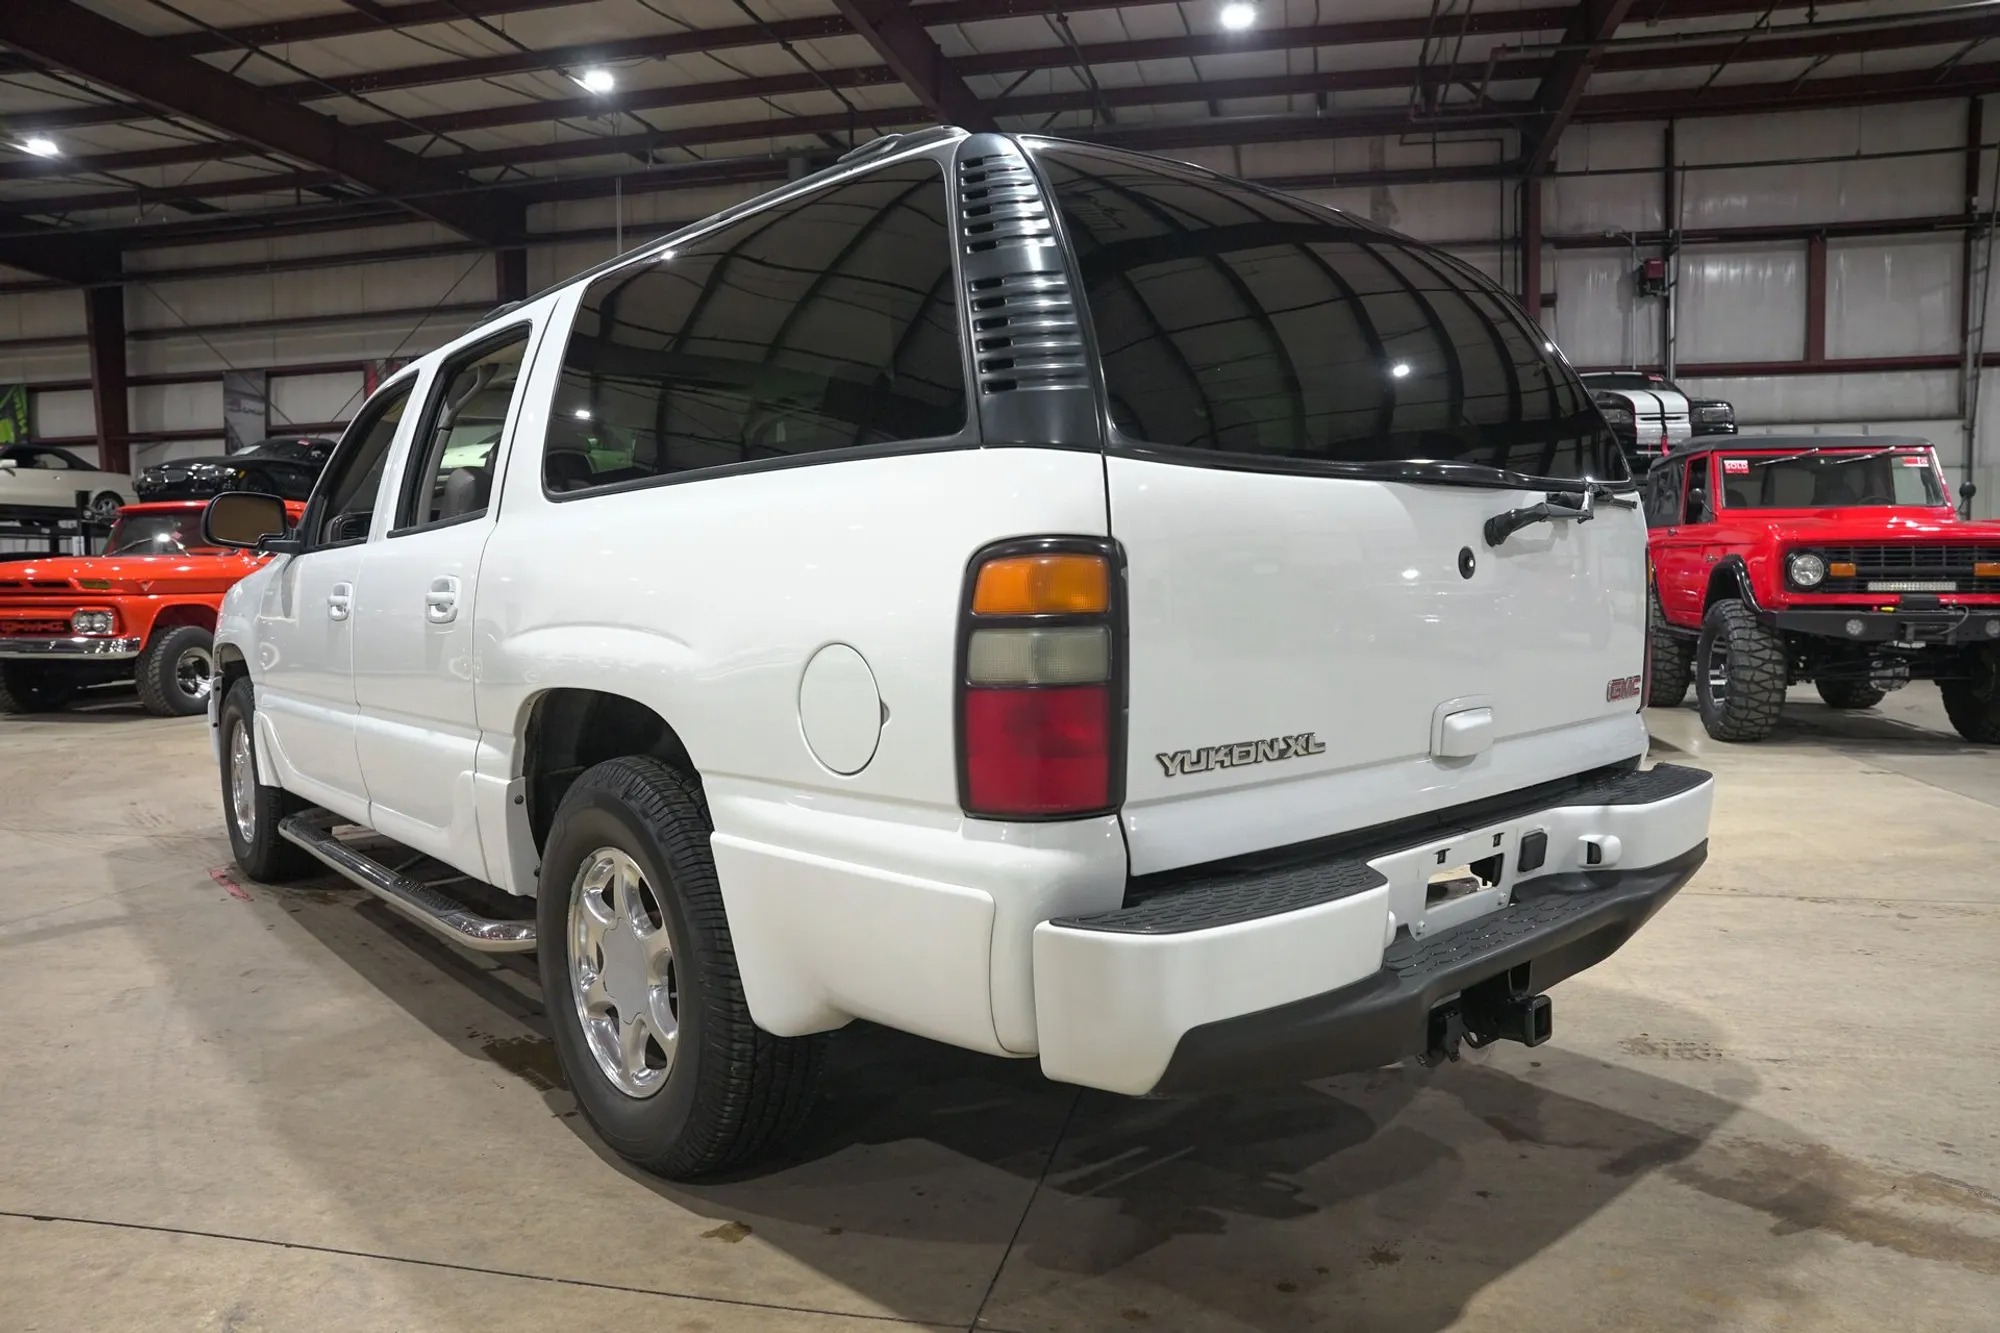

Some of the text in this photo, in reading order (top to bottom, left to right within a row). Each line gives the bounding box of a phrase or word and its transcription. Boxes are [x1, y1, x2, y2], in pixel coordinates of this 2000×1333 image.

[1607, 675, 1641, 702] GMC
[1156, 732, 1326, 777] YUKON XL
